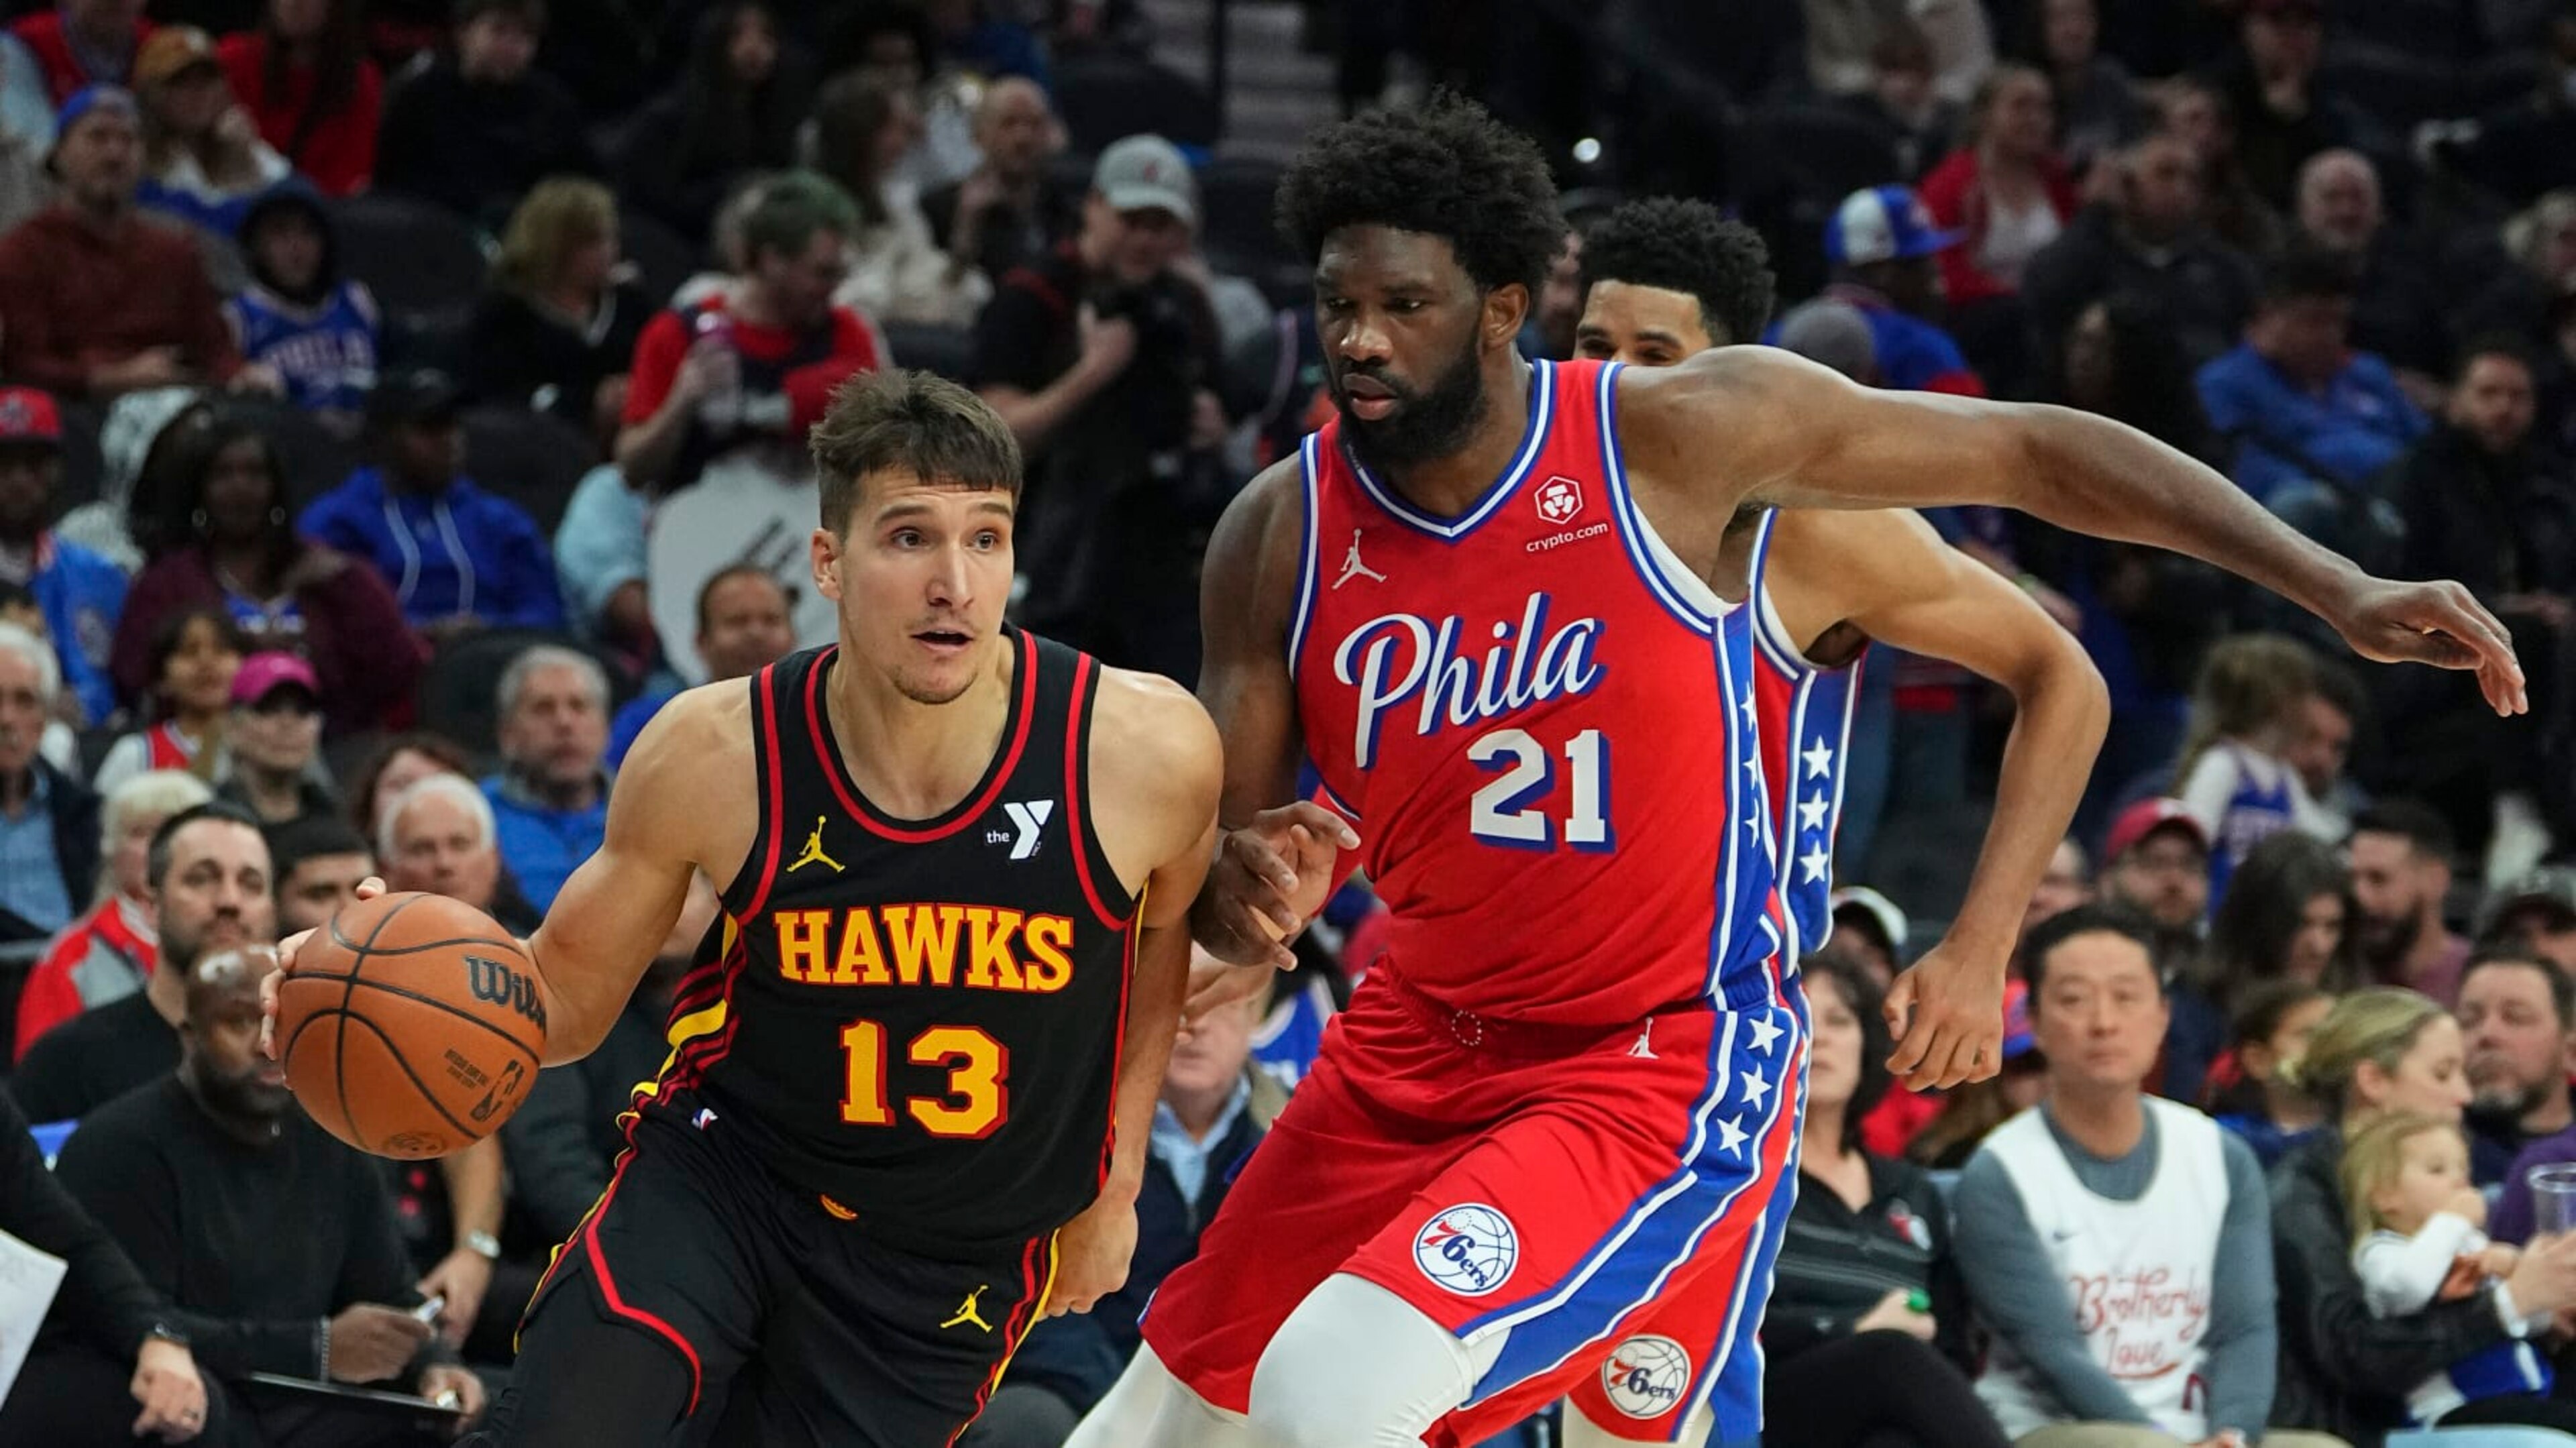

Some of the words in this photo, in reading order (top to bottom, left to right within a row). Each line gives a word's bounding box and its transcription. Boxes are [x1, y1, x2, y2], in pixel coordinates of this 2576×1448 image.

[1526, 523, 1609, 552] crypto.com
[1333, 592, 1607, 771] Phila
[1466, 728, 1615, 853] 21
[986, 830, 1010, 844] the
[773, 903, 1074, 993] HAWKS
[839, 1017, 1010, 1140] 13
[1422, 1220, 1489, 1287] 76ers
[2069, 1266, 2207, 1343] Brotherly
[1609, 1357, 1676, 1400] 76ers
